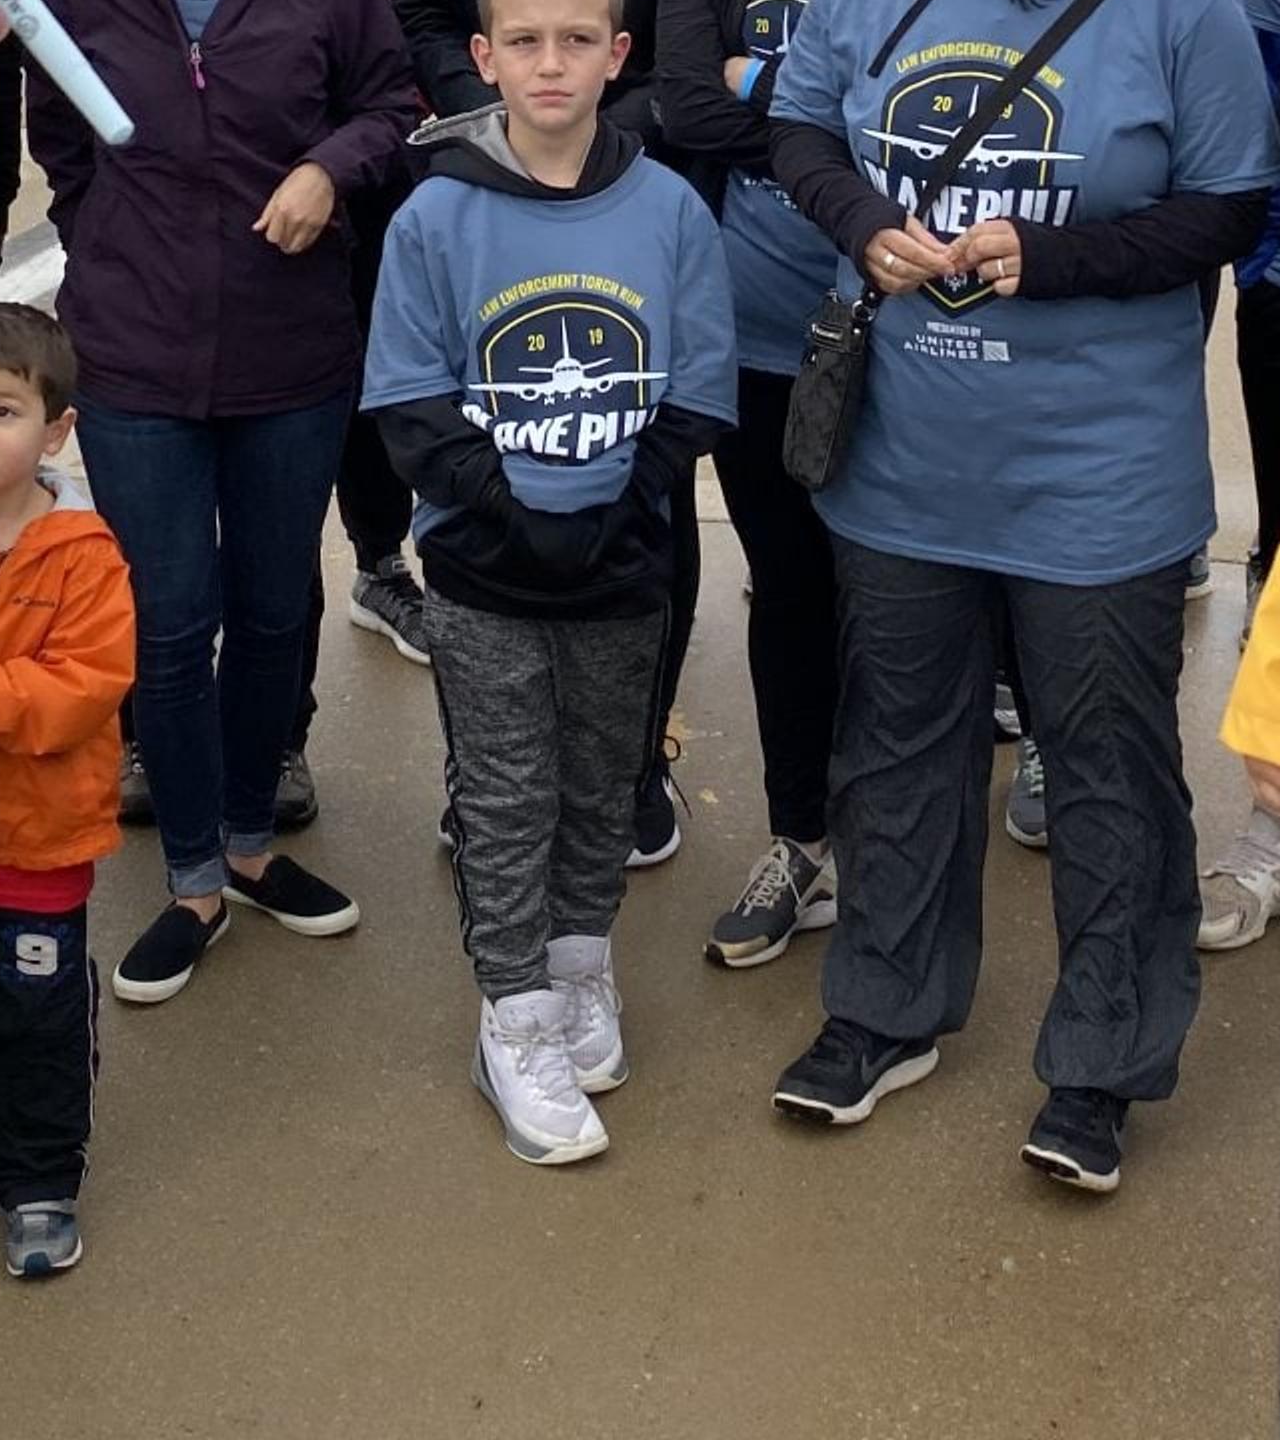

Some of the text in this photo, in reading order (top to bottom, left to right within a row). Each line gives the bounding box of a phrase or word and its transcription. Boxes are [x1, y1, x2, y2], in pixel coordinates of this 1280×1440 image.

[755, 18, 769, 33] 20
[896, 54, 918, 73] LAW
[920, 41, 1001, 63] ENFORCEMENT
[932, 96, 953, 113] 20
[480, 273, 645, 321] LAW ENFORCEMENT TORCH RUN
[527, 327, 604, 351] 20 19
[916, 334, 977, 349] UNITED
[904, 341, 978, 359] AIRLINES
